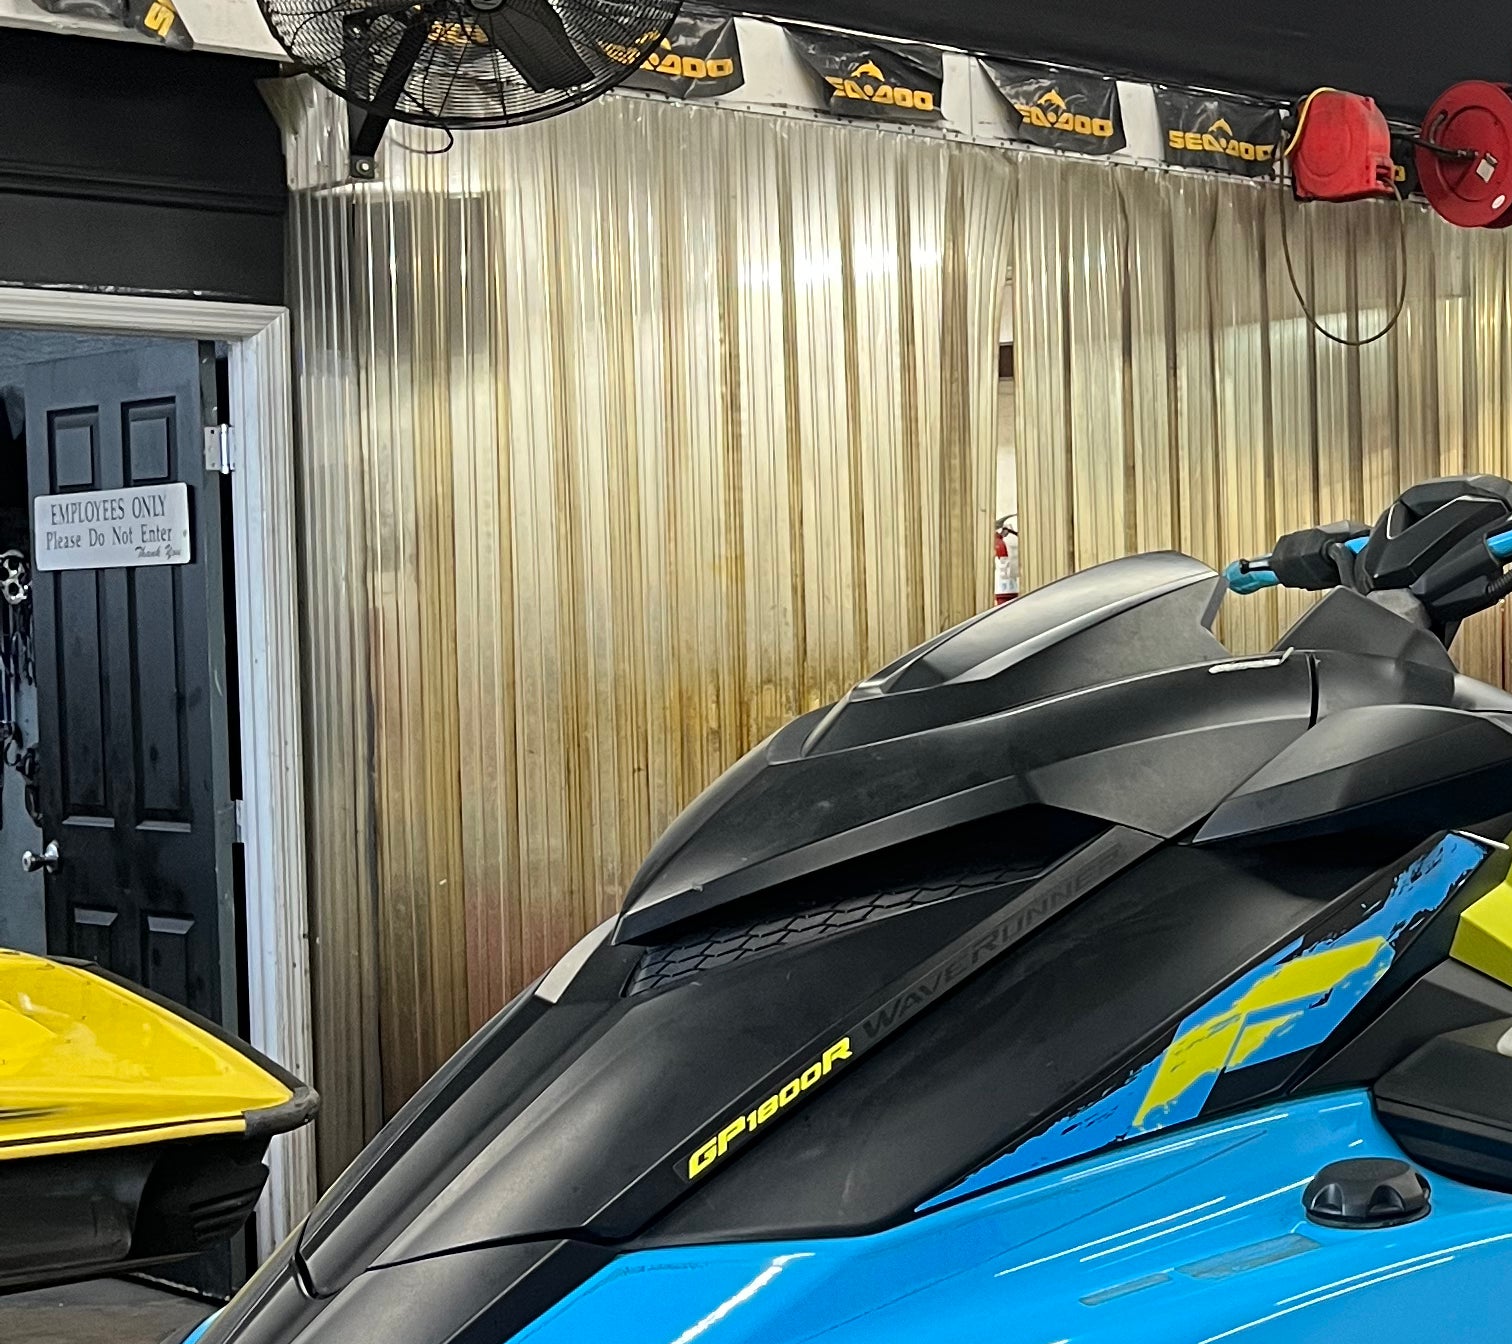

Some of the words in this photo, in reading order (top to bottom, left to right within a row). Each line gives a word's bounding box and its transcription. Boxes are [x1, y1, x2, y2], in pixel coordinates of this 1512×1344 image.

[51, 497, 125, 526] EMPLOYEES
[132, 494, 167, 519] ONLY
[46, 529, 81, 551] Please
[89, 528, 105, 547] Do
[112, 526, 133, 546] Not
[141, 523, 172, 544] Enter
[135, 545, 161, 558] Thank
[164, 543, 182, 560] You
[688, 1037, 853, 1180] GP1800R
